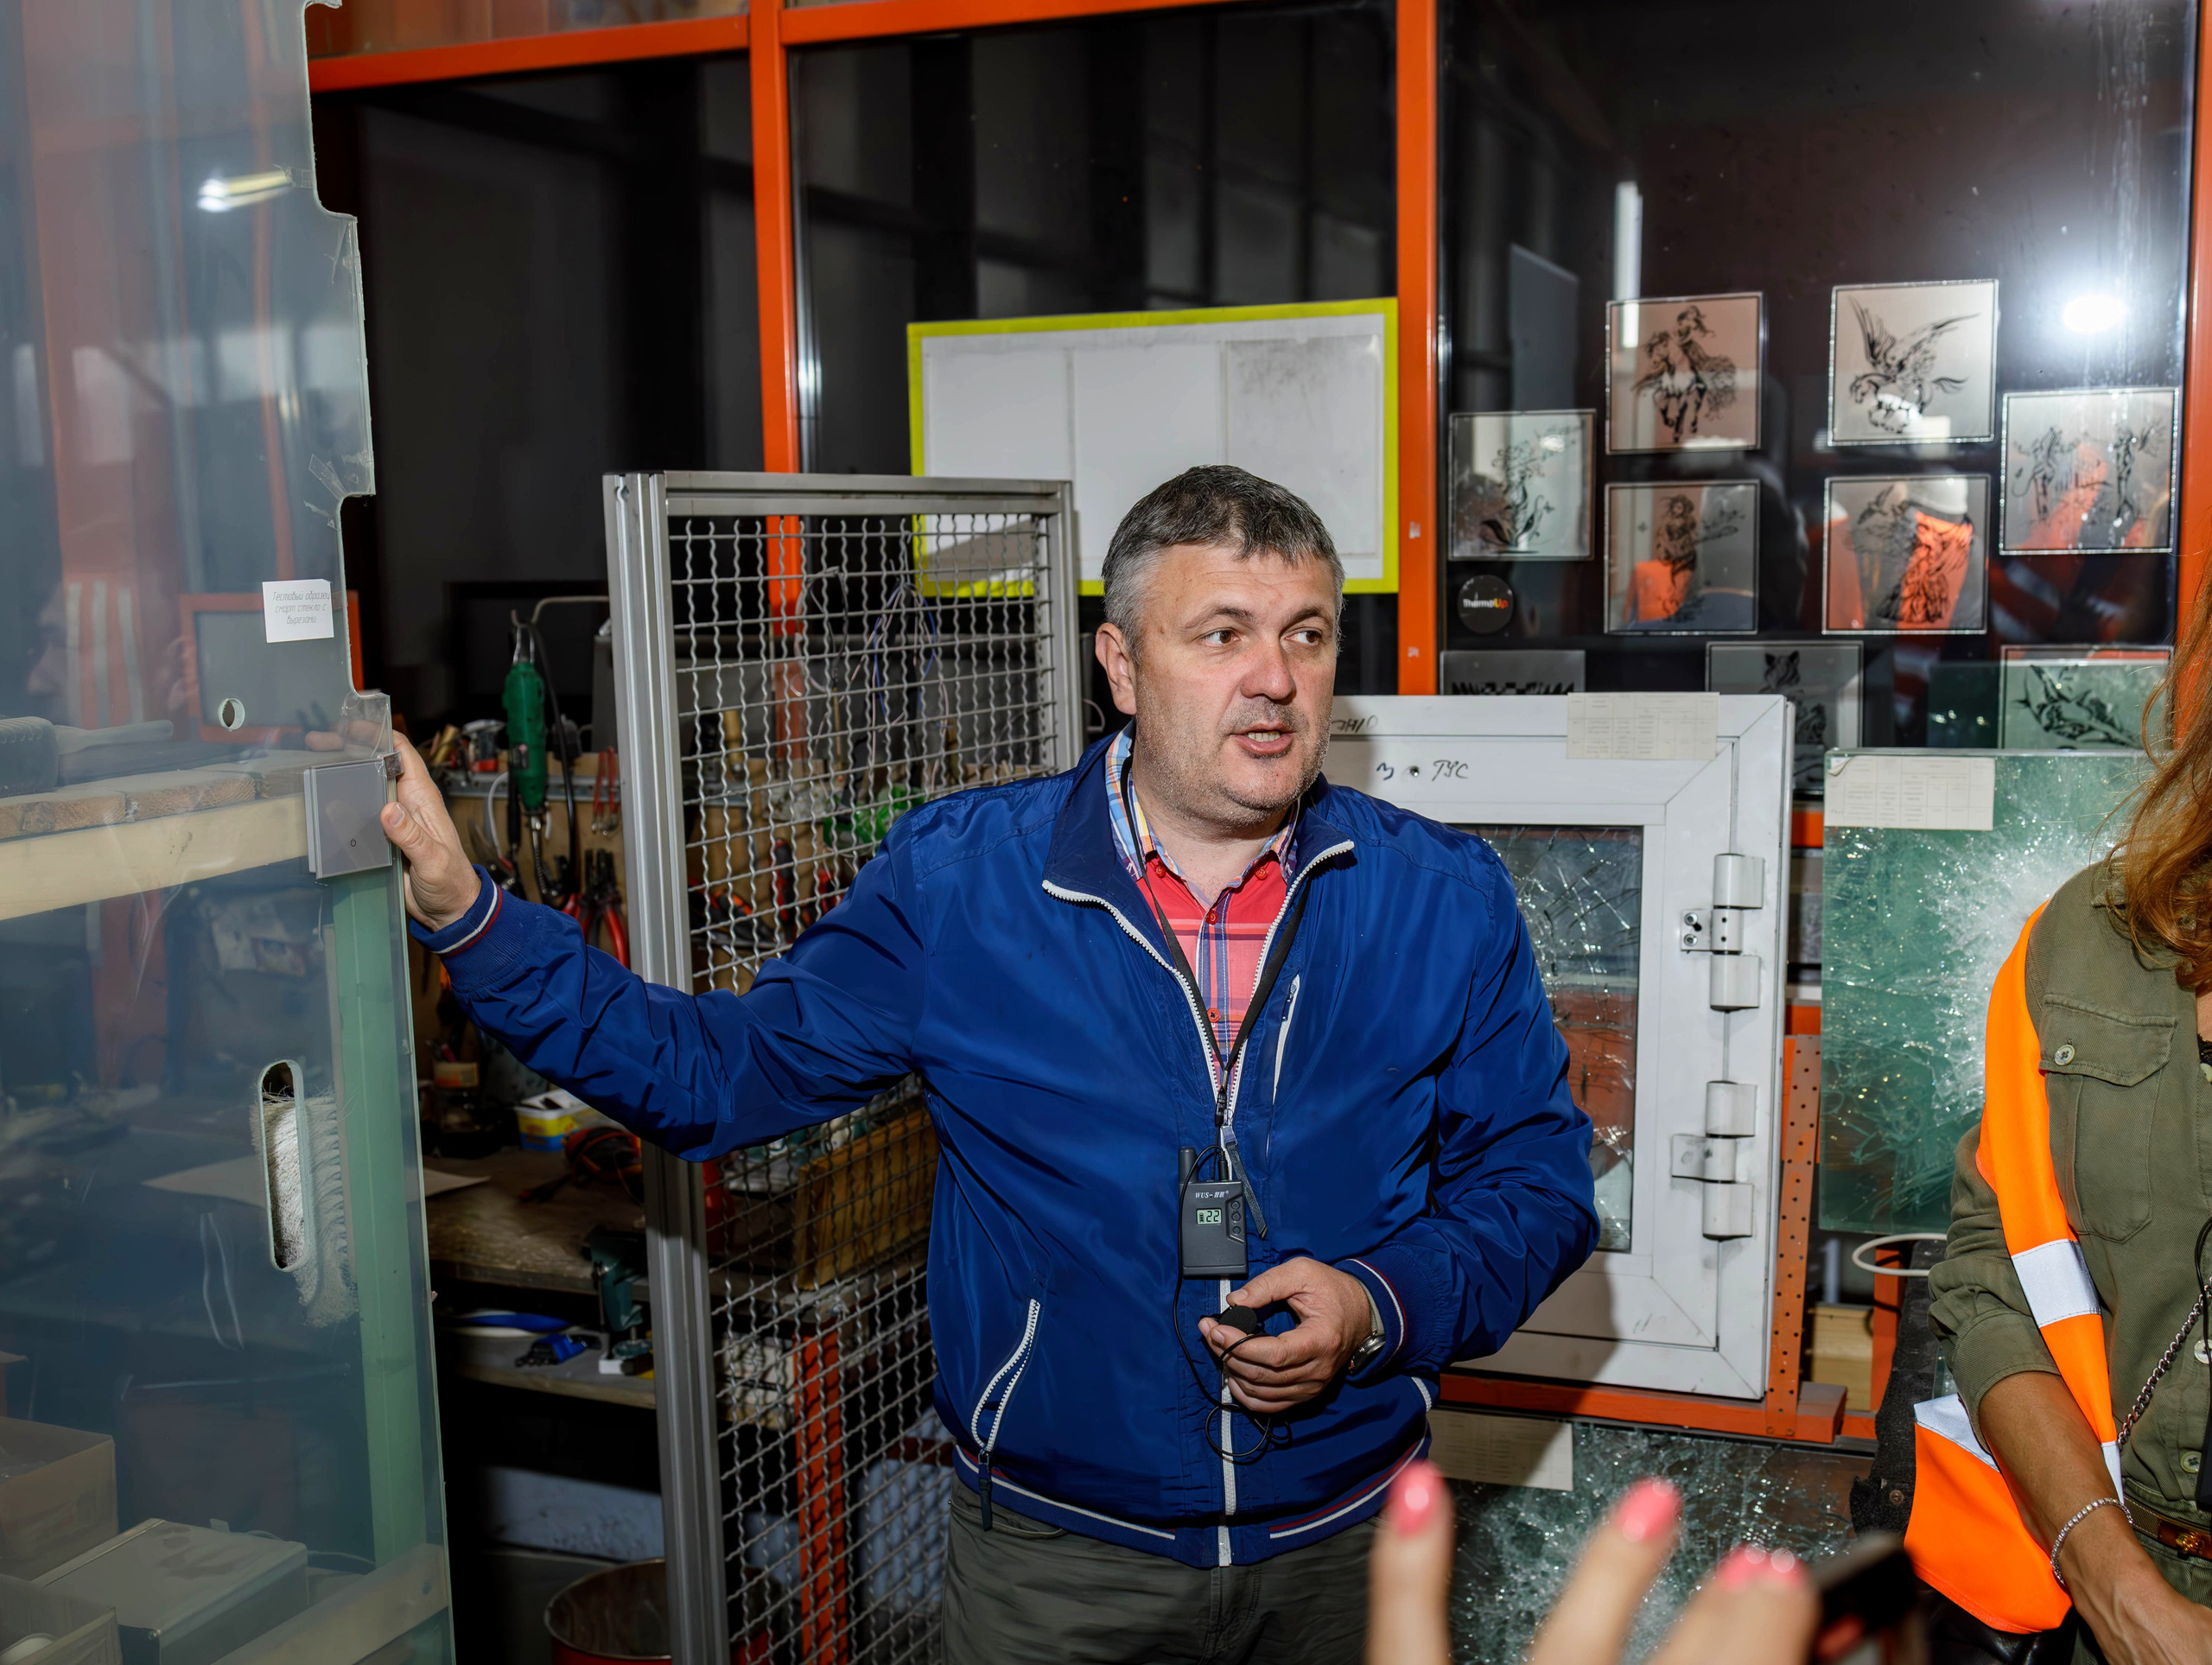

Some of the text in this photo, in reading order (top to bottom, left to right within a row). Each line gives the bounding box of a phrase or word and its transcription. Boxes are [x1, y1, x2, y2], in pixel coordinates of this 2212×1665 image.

[272, 590, 330, 601] Тестовый образец
[275, 604, 296, 614] смарт
[297, 604, 321, 613] стекло
[1205, 1211, 1220, 1223] 22
